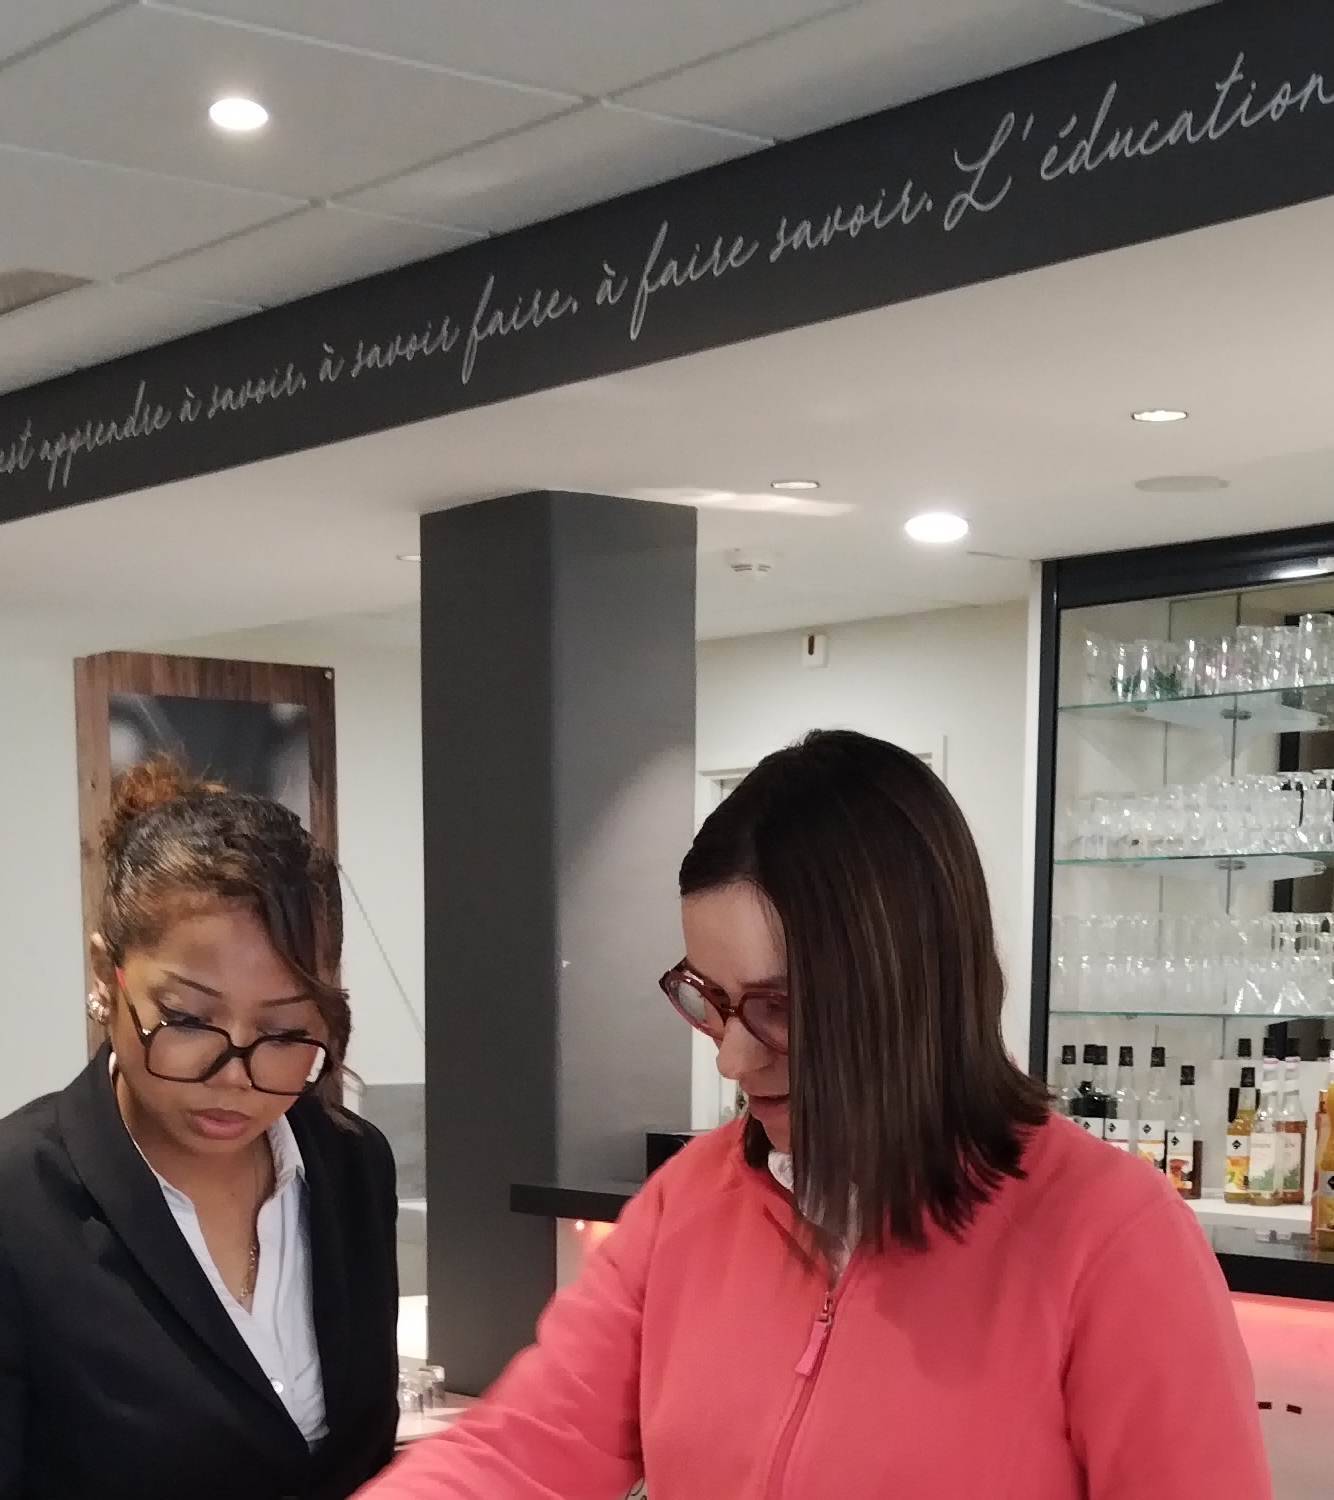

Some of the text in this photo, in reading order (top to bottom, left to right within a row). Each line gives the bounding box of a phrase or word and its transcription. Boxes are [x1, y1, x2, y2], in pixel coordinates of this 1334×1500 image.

[40, 380, 171, 493] apprendre
[179, 385, 201, 422] à
[319, 342, 345, 382] à
[351, 315, 460, 377] savoir
[596, 261, 628, 305] à
[630, 219, 760, 341] faire
[769, 178, 934, 262] savoir.
